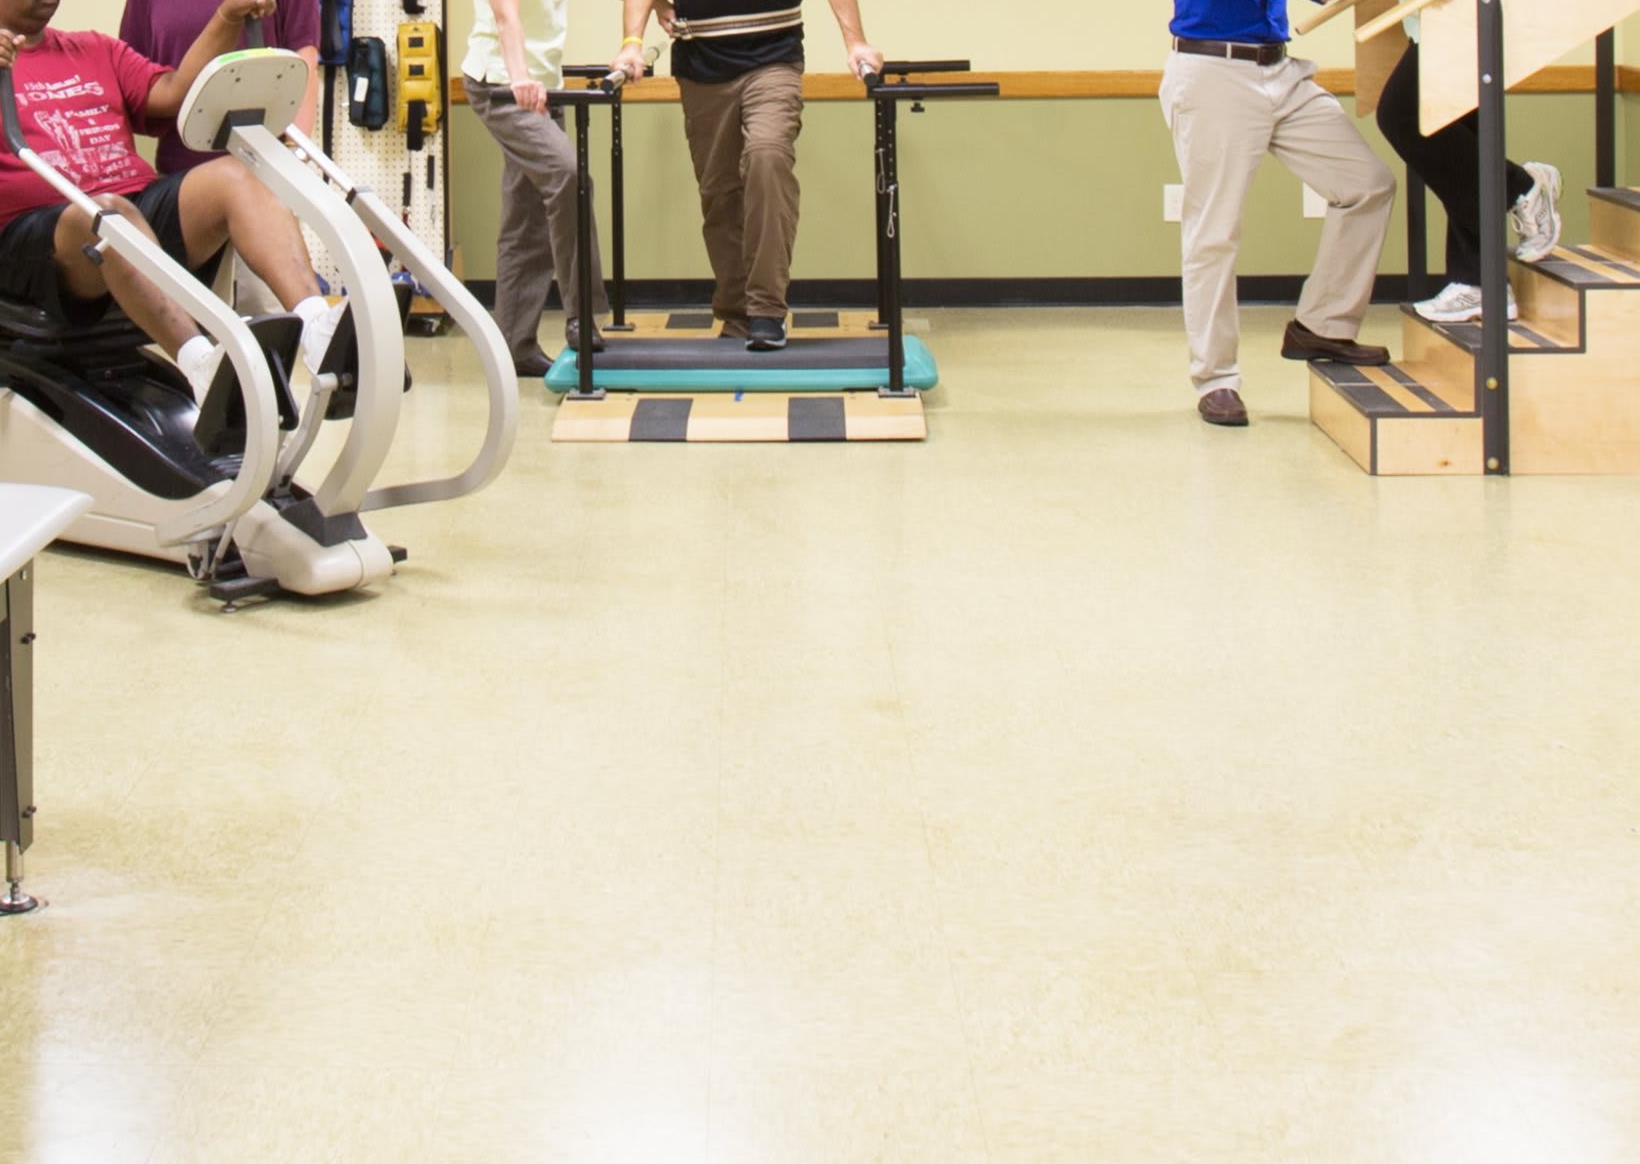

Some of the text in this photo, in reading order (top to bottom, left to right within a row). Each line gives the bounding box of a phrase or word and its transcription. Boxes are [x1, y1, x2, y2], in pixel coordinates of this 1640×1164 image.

[15, 80, 104, 106] JONES
[64, 104, 109, 119] FAMILY
[89, 134, 112, 145] DAY
